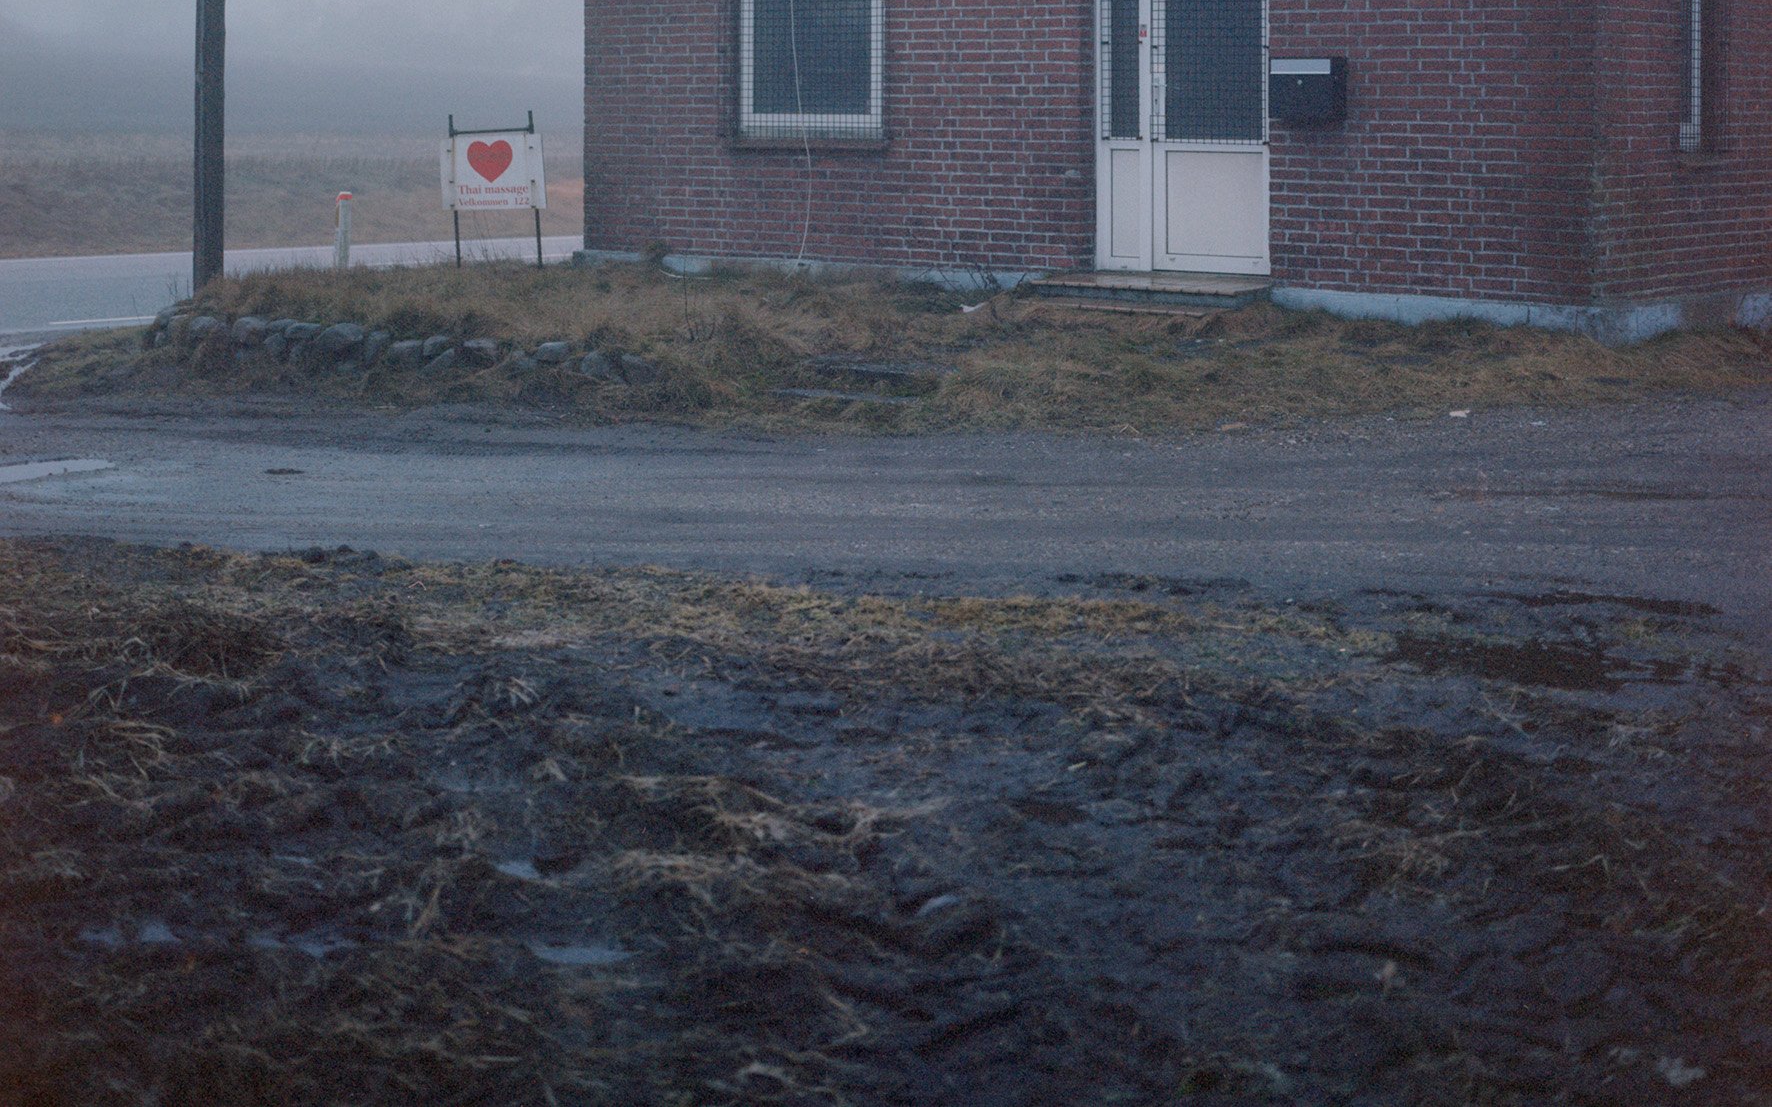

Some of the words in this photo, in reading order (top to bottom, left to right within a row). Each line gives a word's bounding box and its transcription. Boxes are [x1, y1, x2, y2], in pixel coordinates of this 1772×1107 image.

[458, 184, 482, 194] Thai
[484, 184, 529, 196] massage
[458, 198, 509, 206] Velkommen
